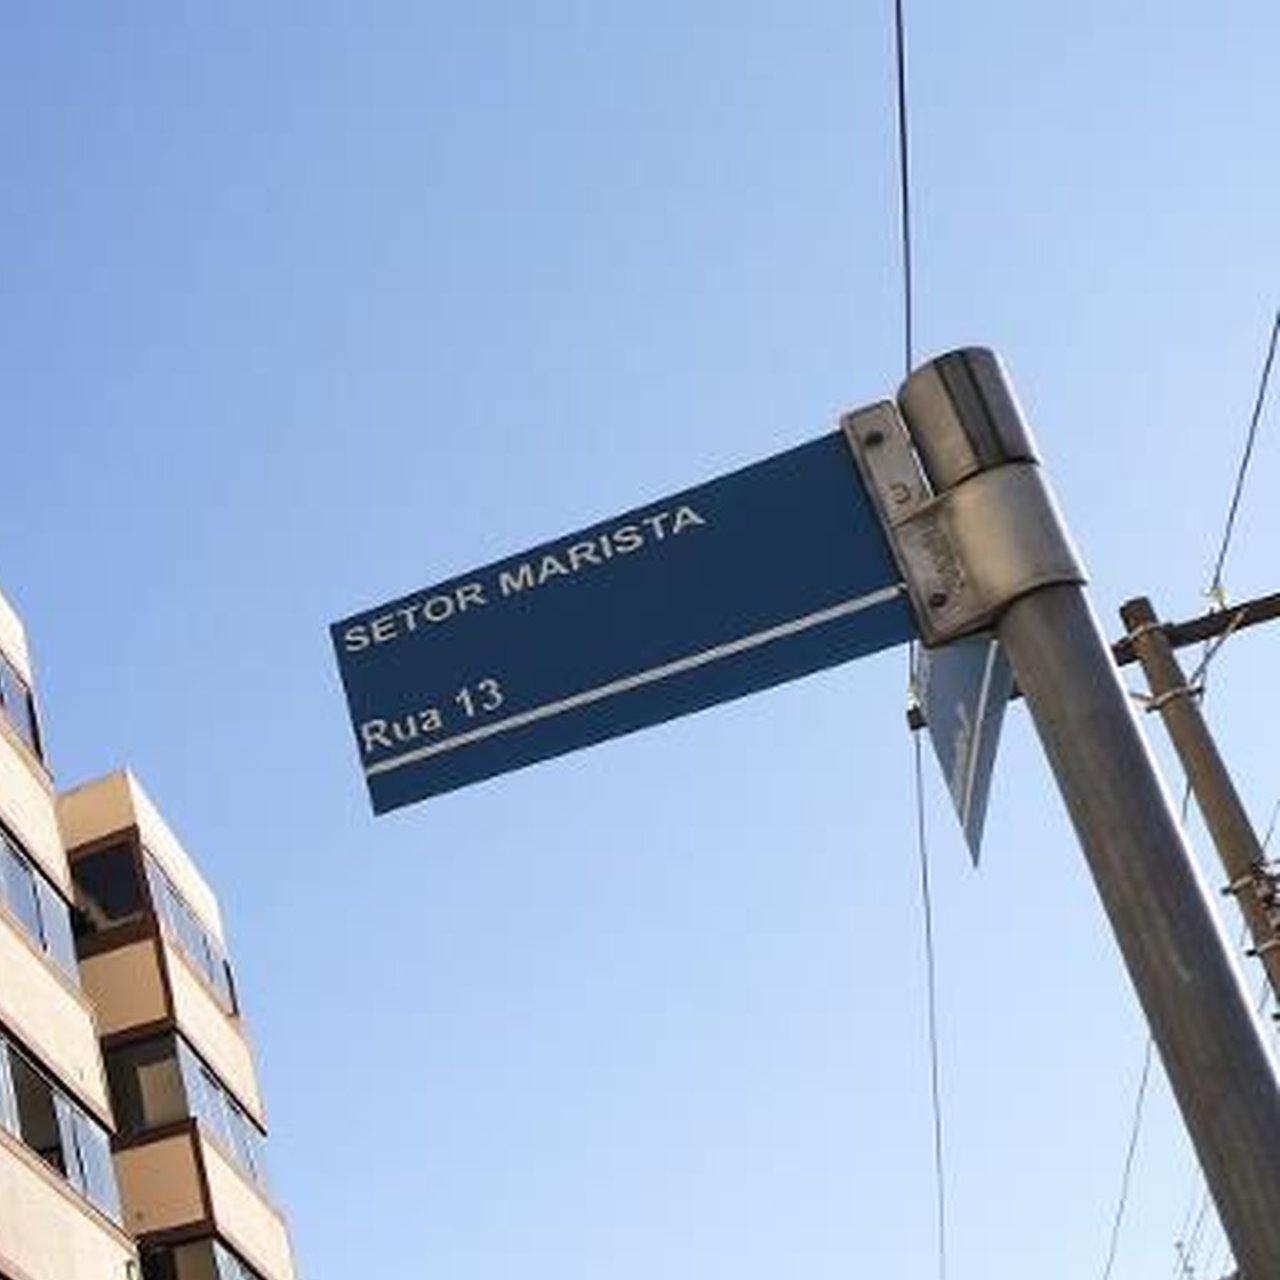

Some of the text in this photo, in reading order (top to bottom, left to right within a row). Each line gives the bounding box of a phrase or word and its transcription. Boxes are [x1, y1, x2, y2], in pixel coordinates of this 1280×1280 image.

[344, 504, 705, 652] SETOR MARISTA
[360, 677, 504, 752] Rua 13
